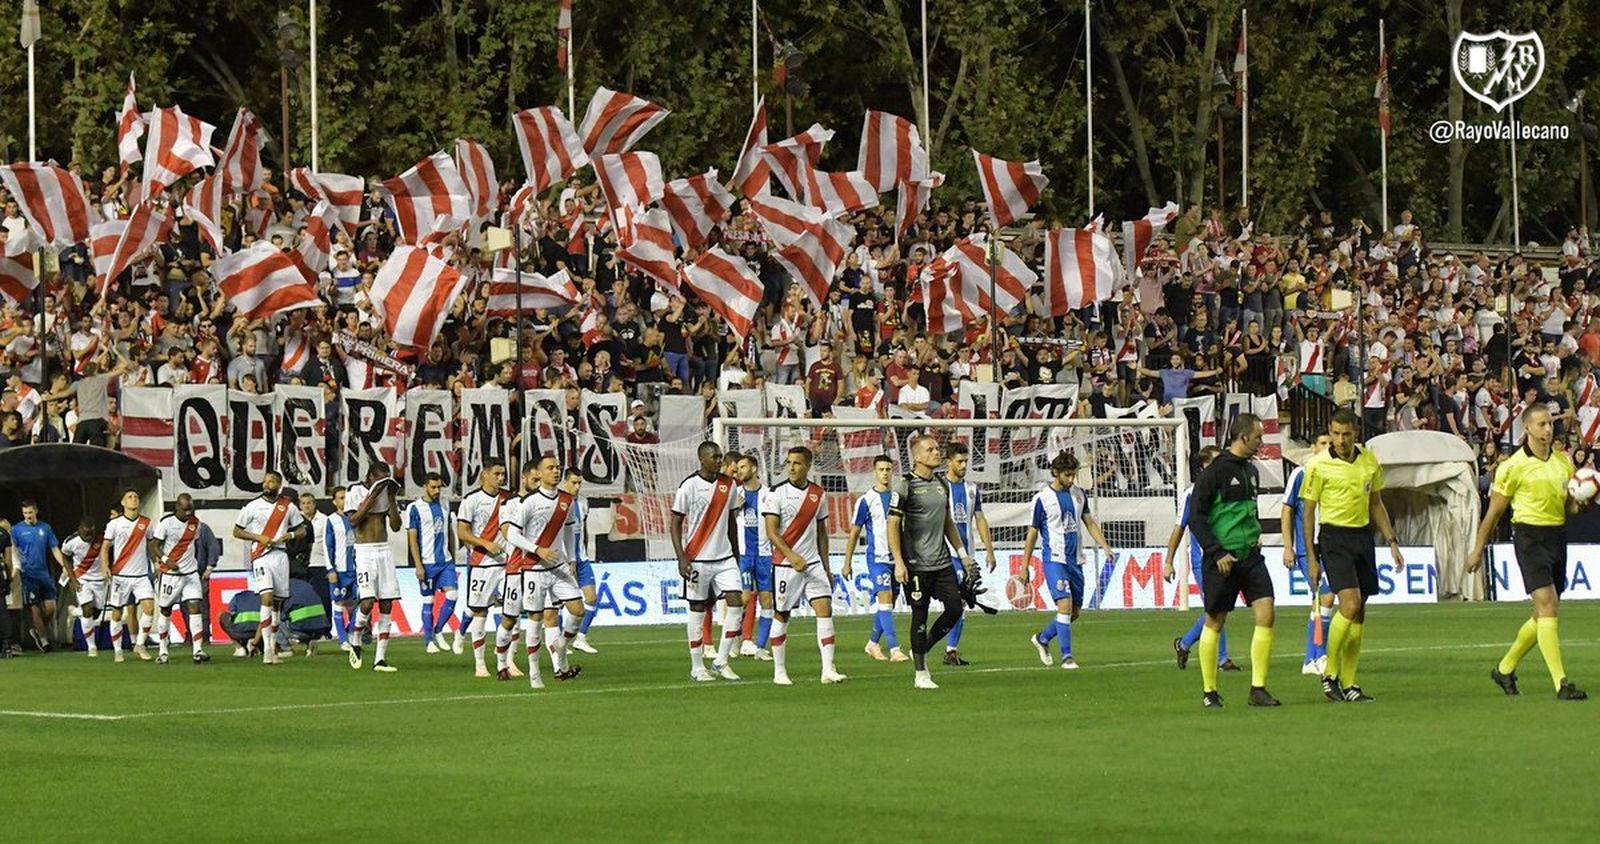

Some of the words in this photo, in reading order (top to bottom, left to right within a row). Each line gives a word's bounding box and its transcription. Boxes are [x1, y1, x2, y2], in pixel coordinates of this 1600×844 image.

[177, 397, 619, 492] QUEREMOS
[358, 571, 370, 583] 21
[163, 584, 173, 595] 10
[471, 579, 486, 592] 27
[528, 581, 536, 594] 9
[779, 580, 787, 593] 8
[507, 587, 518, 600] 16
